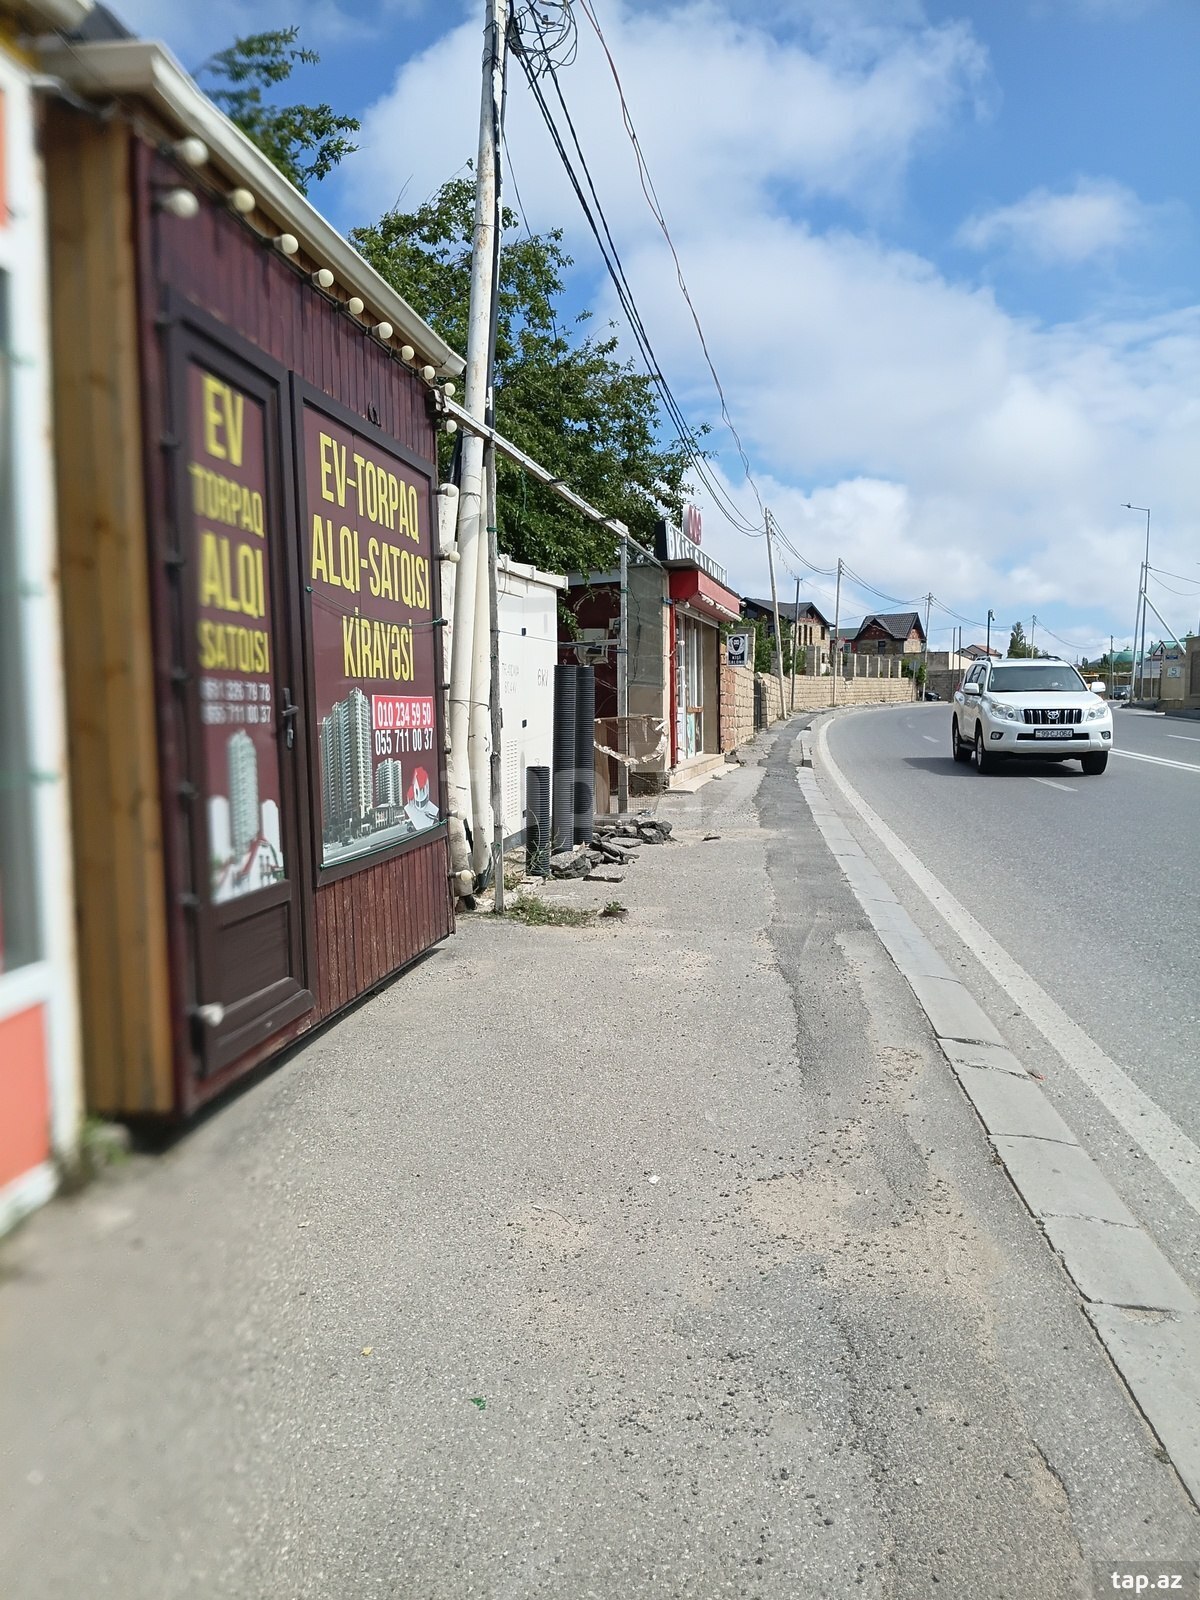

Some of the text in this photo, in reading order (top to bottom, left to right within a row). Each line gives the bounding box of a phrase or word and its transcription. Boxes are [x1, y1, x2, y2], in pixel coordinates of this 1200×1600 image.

[203, 374, 244, 466] EV
[189, 462, 264, 538] TORPAQ
[319, 431, 420, 544] EV-TORPAQ
[201, 530, 265, 619] ALQI
[311, 513, 430, 611] ALQI-SATQISI
[200, 619, 269, 673] SATQISI
[342, 606, 415, 682] KİRAYƏSİ
[259, 683, 271, 703] 78
[260, 705, 272, 724] 37
[377, 701, 431, 727] 010 234 59 50
[375, 728, 433, 755] 055 711 00 37
